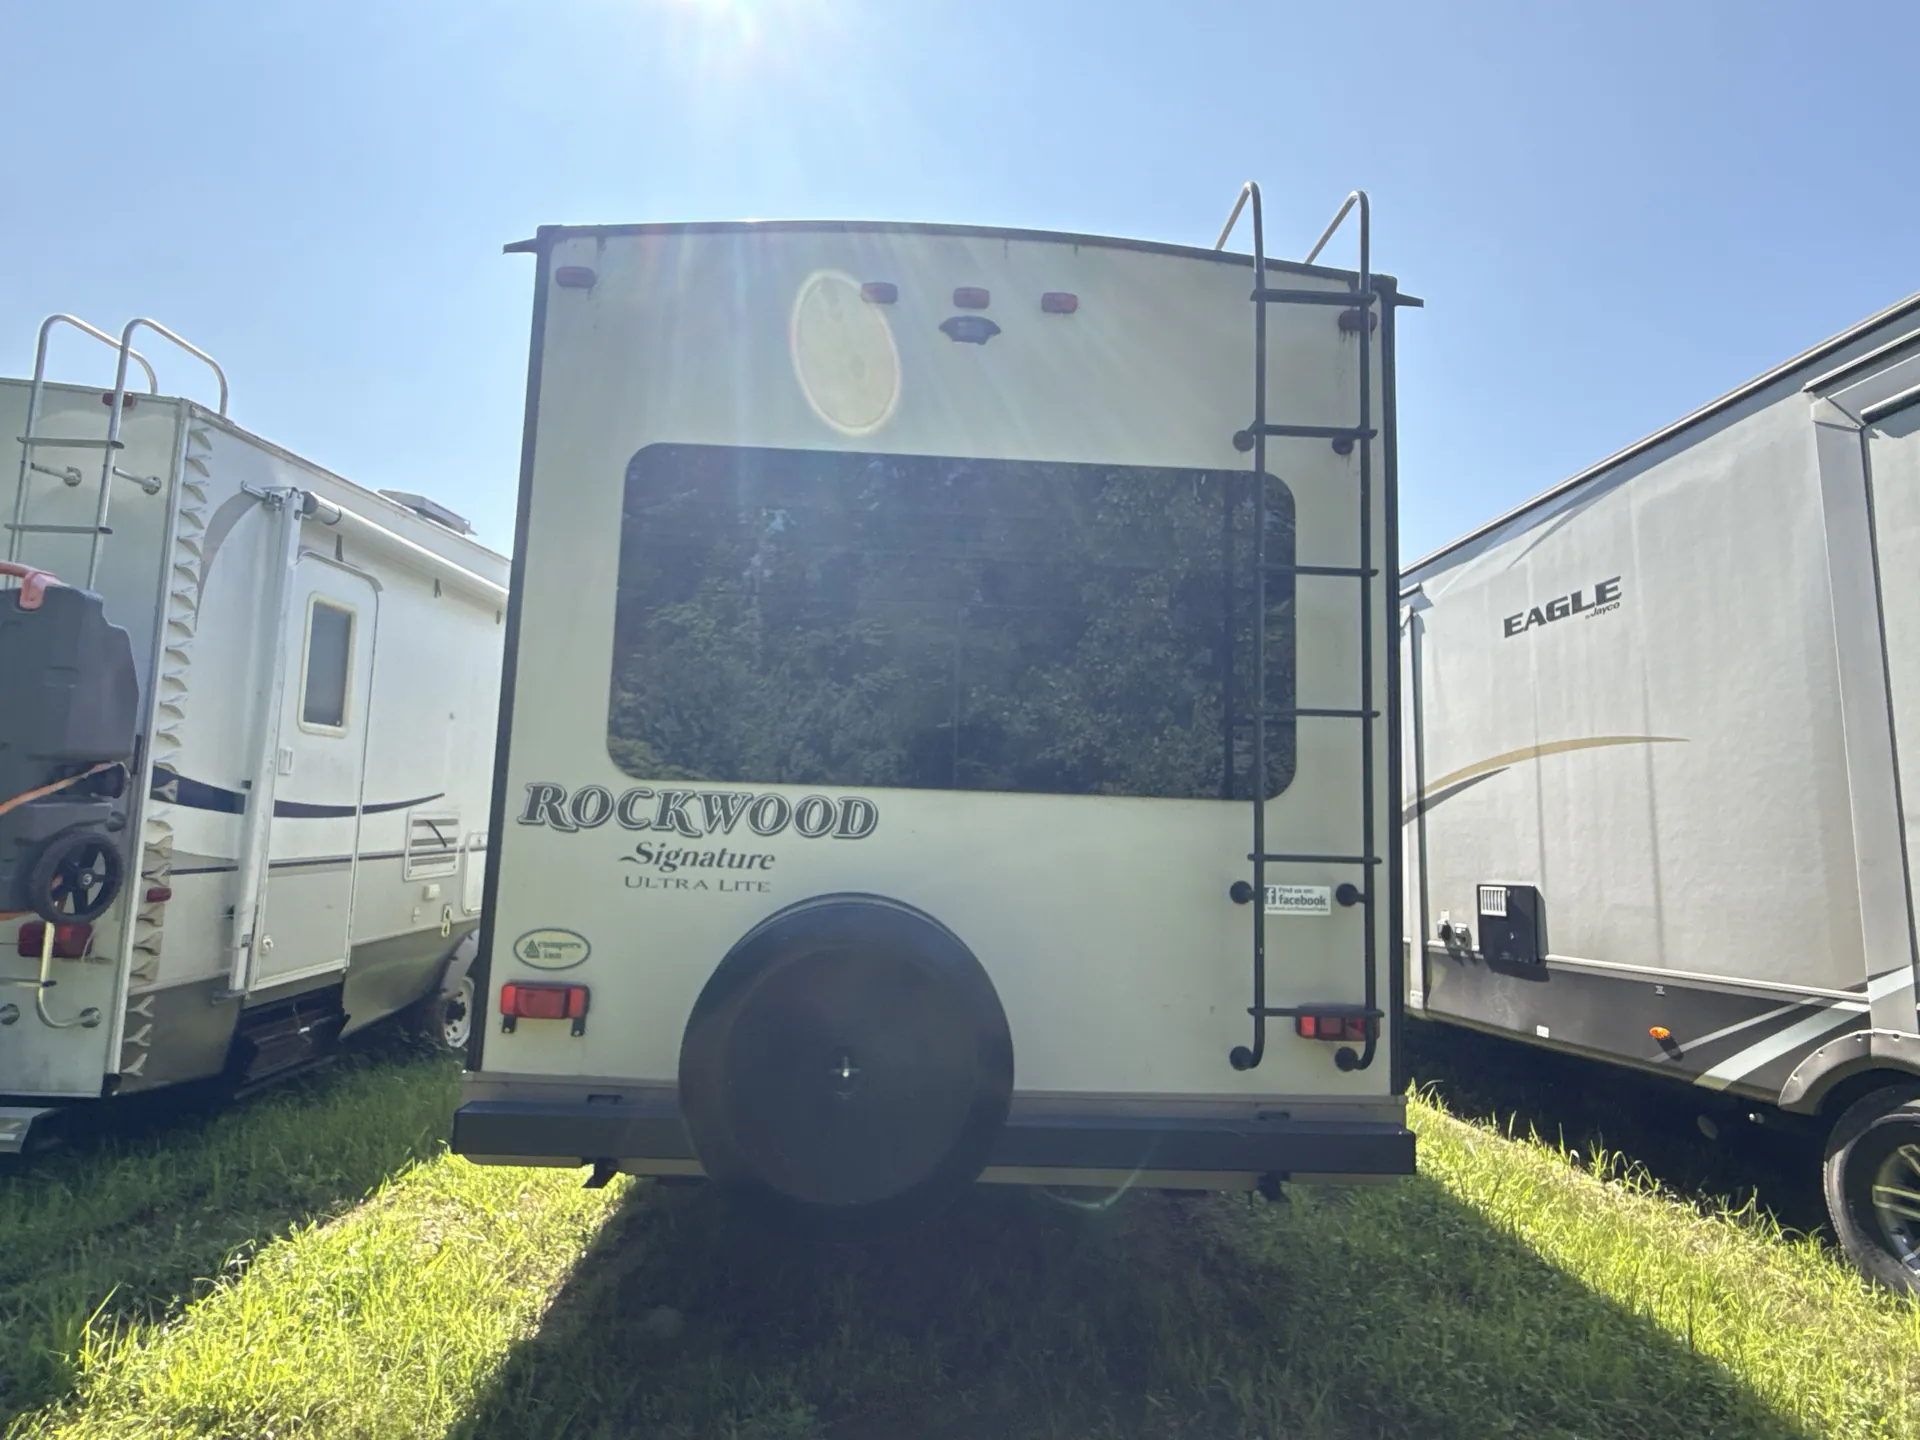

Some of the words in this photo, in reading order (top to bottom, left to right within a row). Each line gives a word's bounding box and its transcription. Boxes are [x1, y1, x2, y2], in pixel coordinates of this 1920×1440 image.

[1503, 575, 1623, 639] EAGLE
[1590, 602, 1621, 618] Jayco
[517, 782, 880, 840] ROCKWOOD
[619, 841, 776, 873] Signature
[624, 875, 709, 892] ULTRA
[718, 879, 772, 893] LITE
[1278, 894, 1326, 905] facebook
